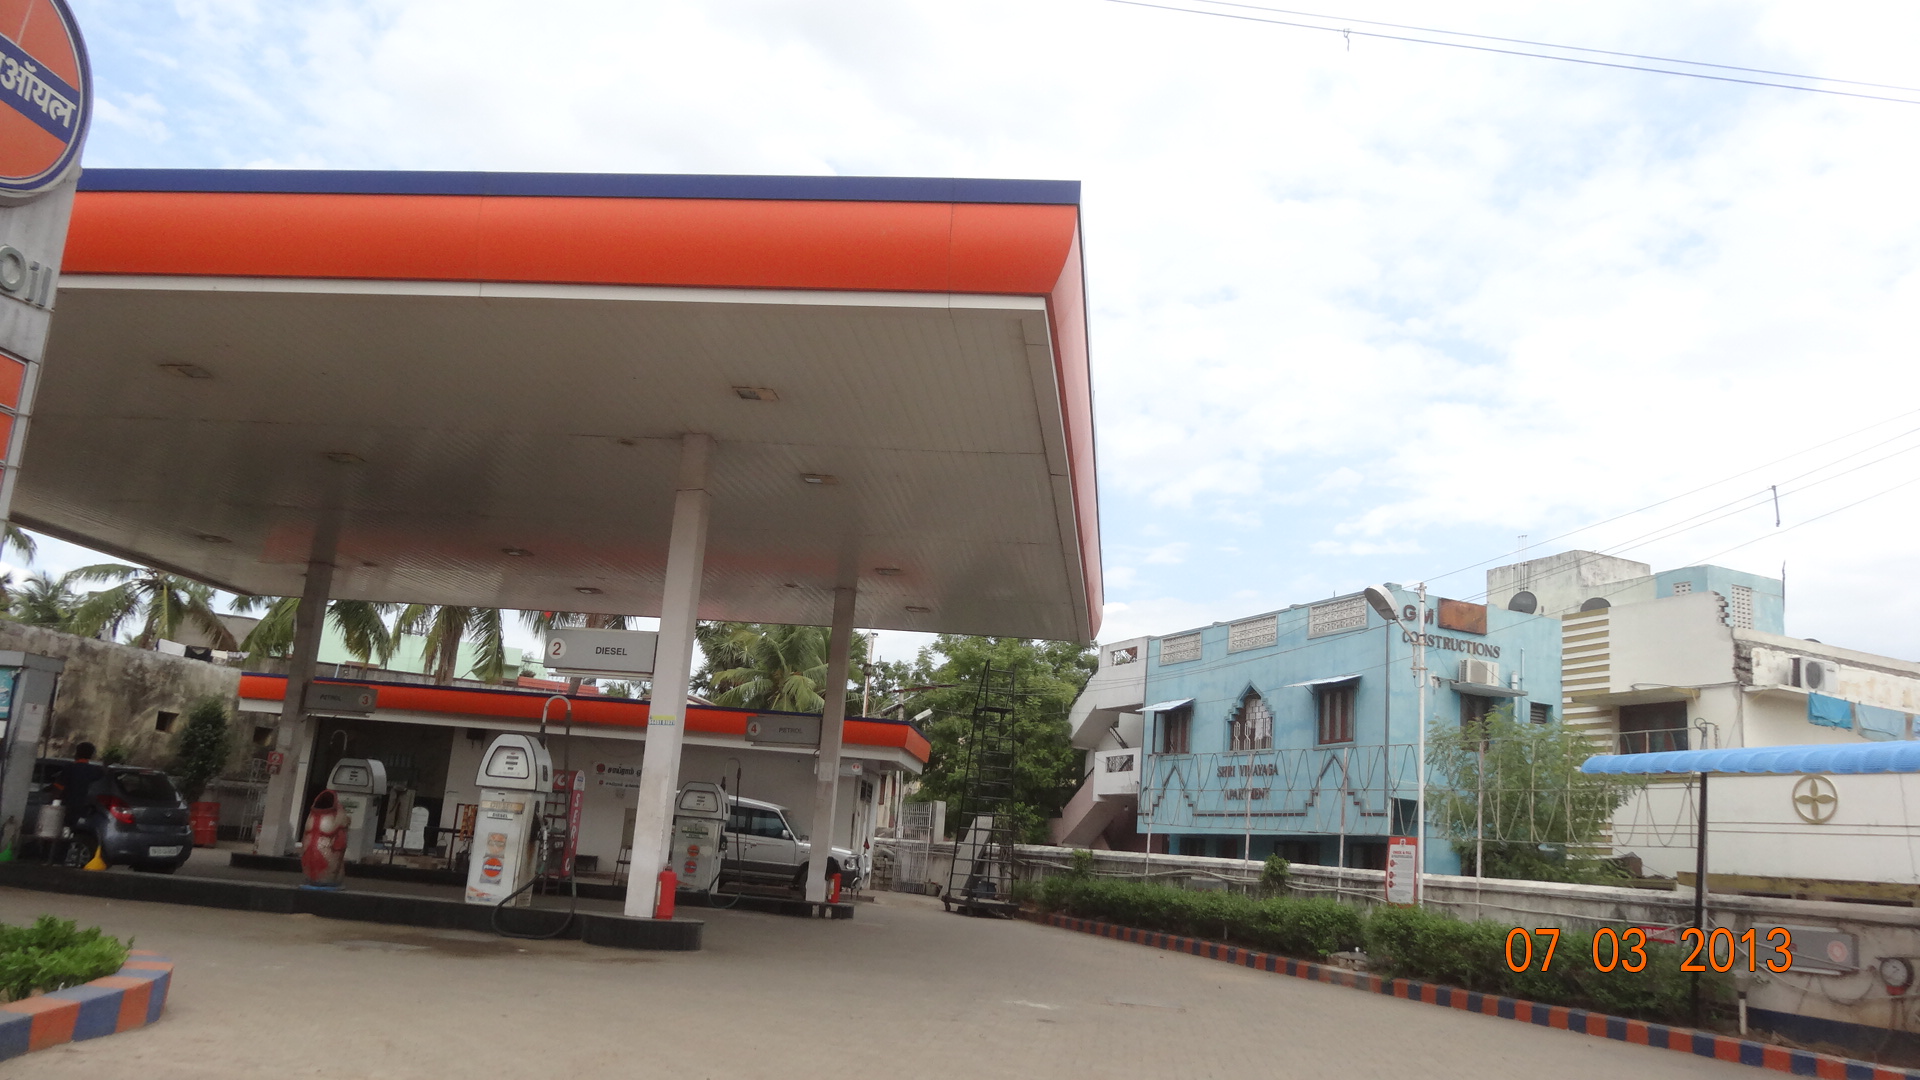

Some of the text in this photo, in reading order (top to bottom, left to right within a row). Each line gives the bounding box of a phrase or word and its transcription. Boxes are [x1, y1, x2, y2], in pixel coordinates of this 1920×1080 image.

[0, 51, 77, 128] ऑयल
[552, 642, 627, 656] 2 DIESEL
[362, 696, 369, 705] 3
[750, 724, 757, 734] 4
[1217, 765, 1236, 778] SHRI
